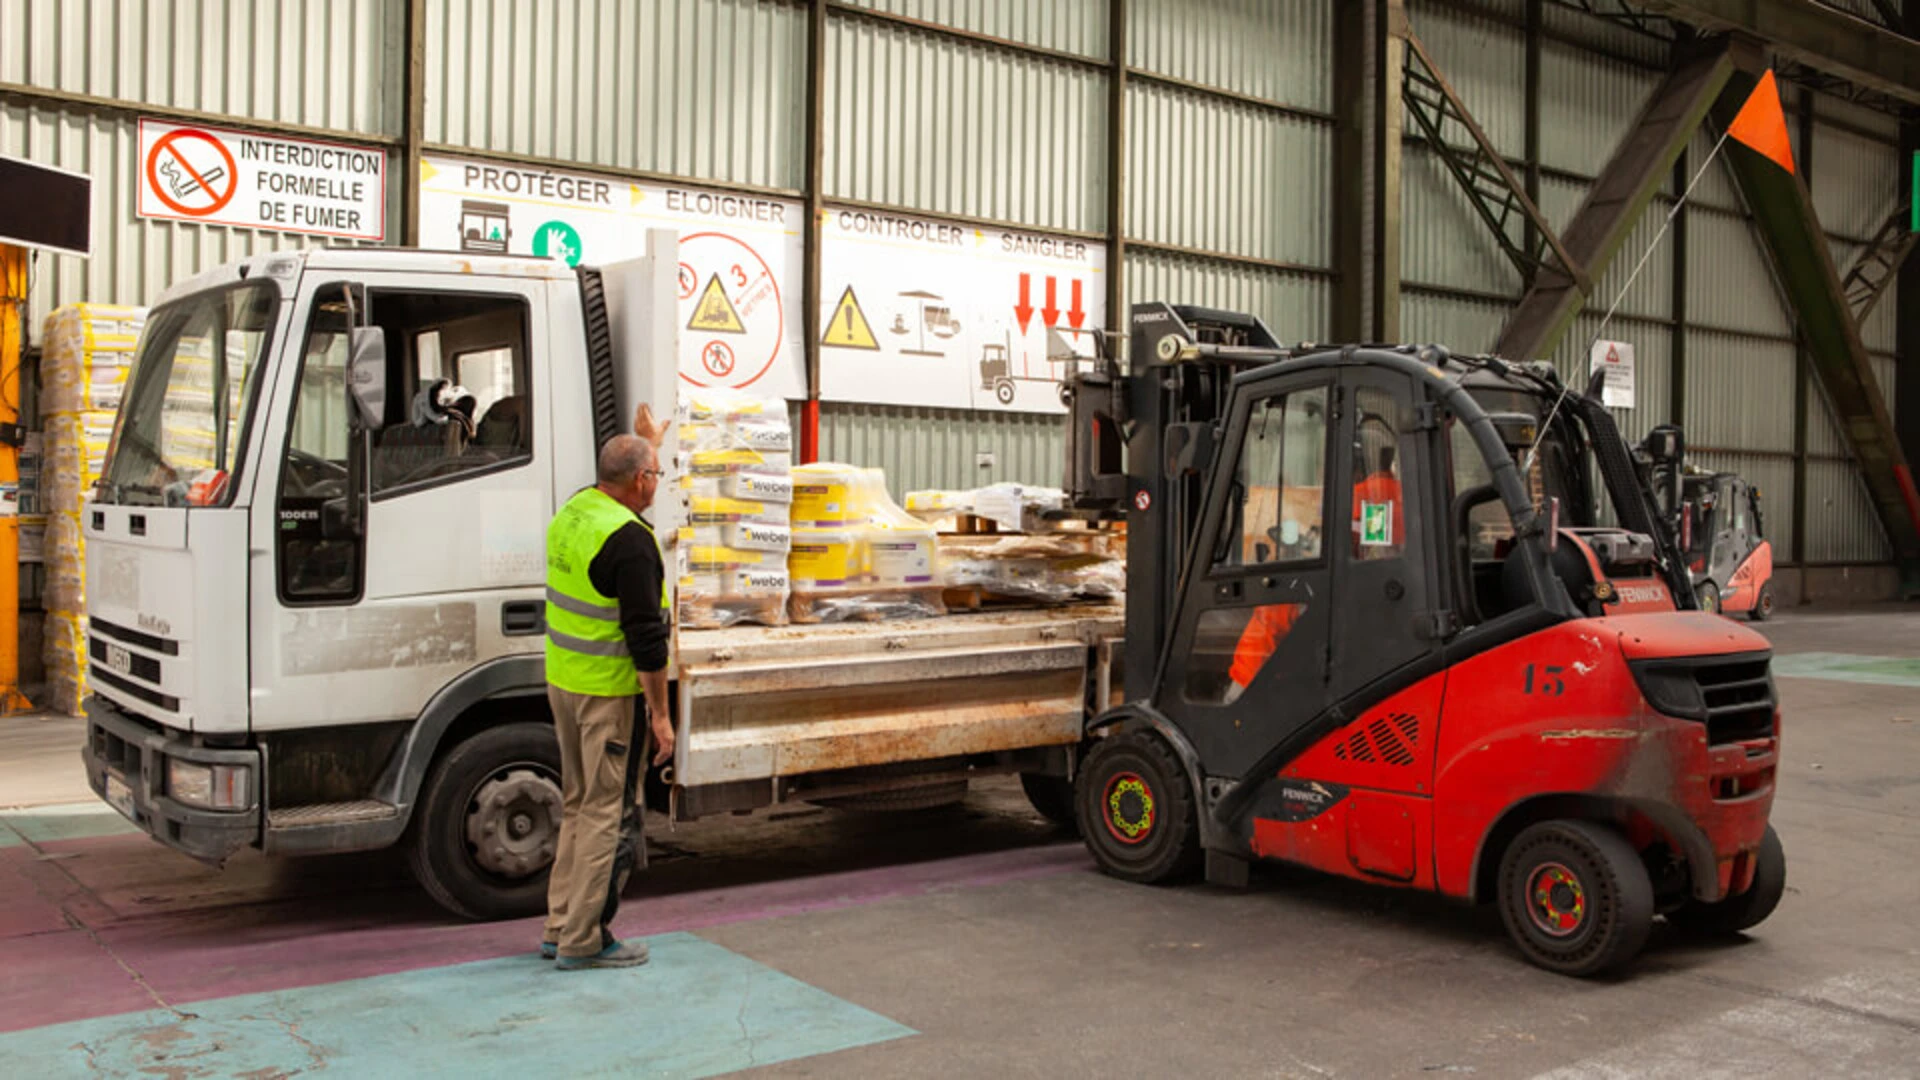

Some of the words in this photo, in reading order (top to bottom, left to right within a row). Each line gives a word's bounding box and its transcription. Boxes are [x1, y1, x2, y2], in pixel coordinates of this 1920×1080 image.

[241, 139, 379, 175] INTERDICTION
[257, 170, 364, 202] FORMELLE
[464, 165, 612, 204] PROTÉGER
[260, 201, 286, 222] DE
[293, 204, 361, 230] FUMER
[666, 190, 785, 224] ELOIGNER
[839, 211, 963, 246] CONTROLER
[1001, 233, 1087, 261] SANGLER
[731, 264, 748, 287] 3
[1133, 311, 1169, 323] FENWICK
[1617, 585, 1668, 604] FENWICK
[1523, 663, 1565, 698] 15
[1283, 787, 1324, 803] FENWICK
